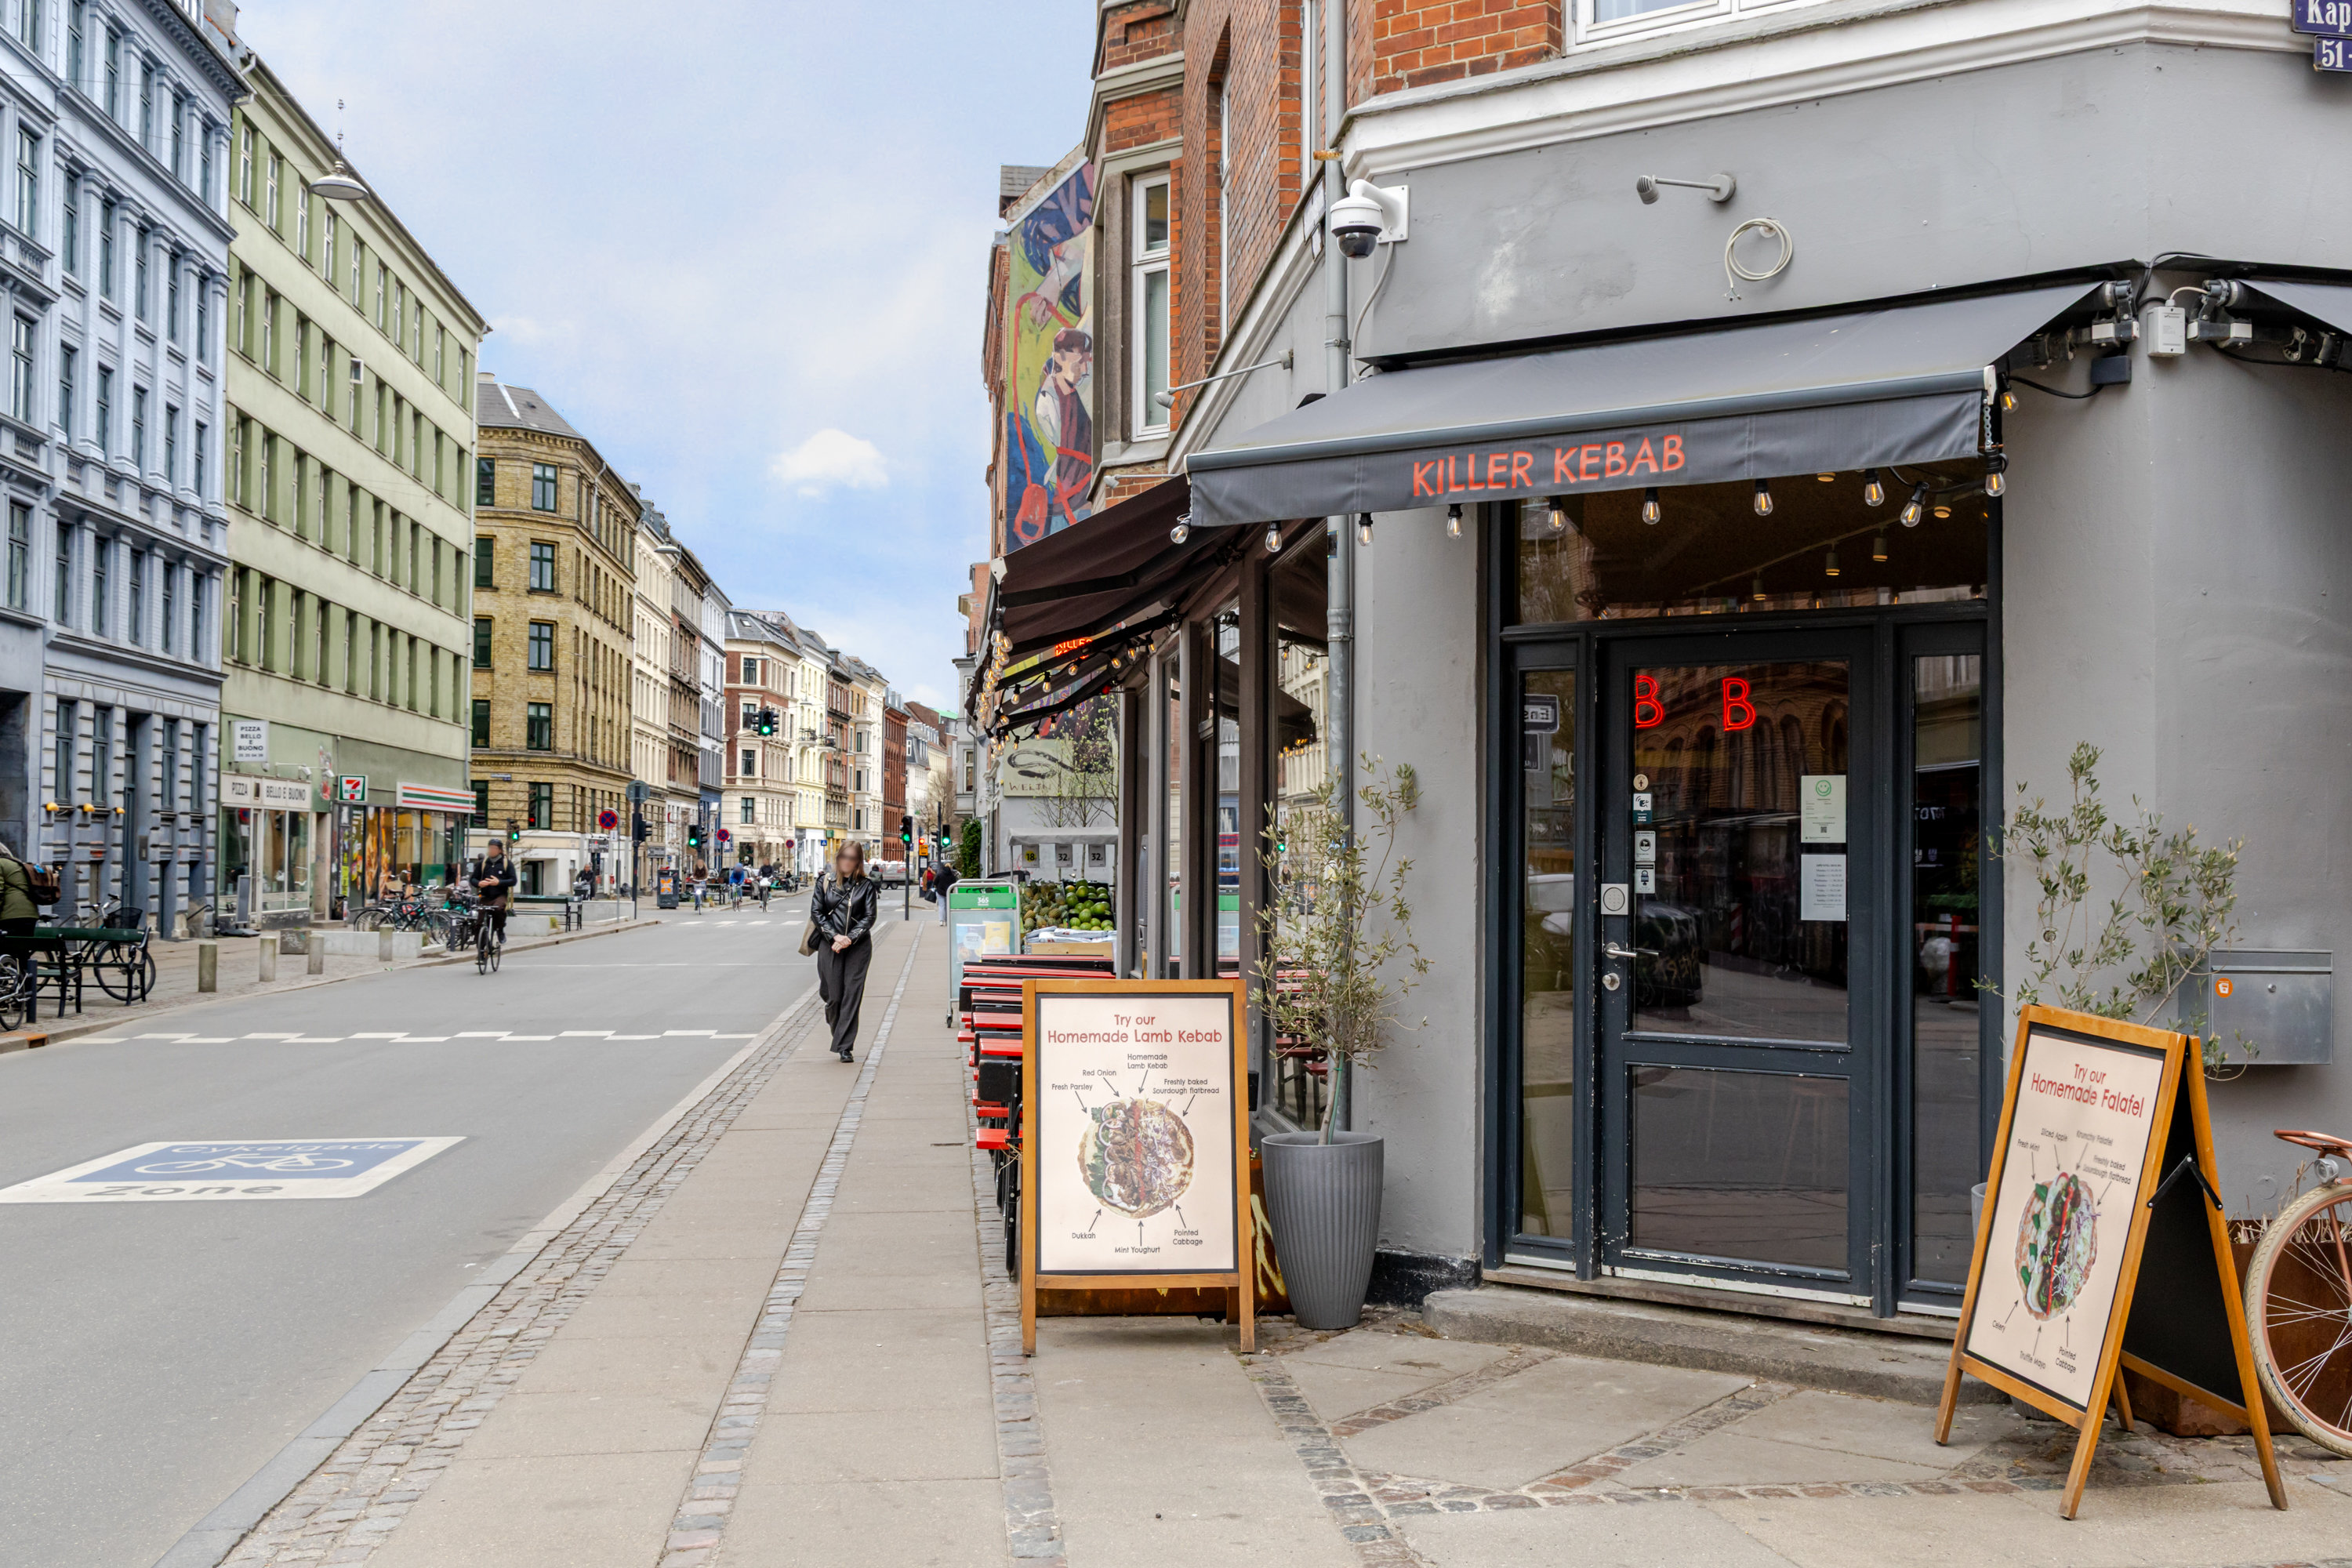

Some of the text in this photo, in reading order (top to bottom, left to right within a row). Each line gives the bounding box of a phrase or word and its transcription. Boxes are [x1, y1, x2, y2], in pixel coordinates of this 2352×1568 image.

[1413, 434, 1686, 497] KILLER KEBAB
[232, 782, 248, 796] PIZZA
[266, 785, 306, 801] BELLO E BUONO
[1114, 1014, 1156, 1027] Try our
[1048, 1029, 1222, 1043] Homemade Lamb Kebab
[2074, 1063, 2107, 1085] Try our
[2031, 1072, 2145, 1118] Homemade Falafel
[2041, 1127, 2068, 1142] Sliced Apple
[171, 1143, 404, 1154] Cykelgade
[2017, 1139, 2040, 1152] Fresh Mint
[2093, 1155, 2126, 1171] Freshly baked
[2109, 1171, 2131, 1185] flatbread
[1992, 1320, 2006, 1333] Celery
[2019, 1350, 2046, 1370] Truffle Mayo
[2058, 1346, 2076, 1360] Pointed
[2055, 1357, 2076, 1374] Cabbage
